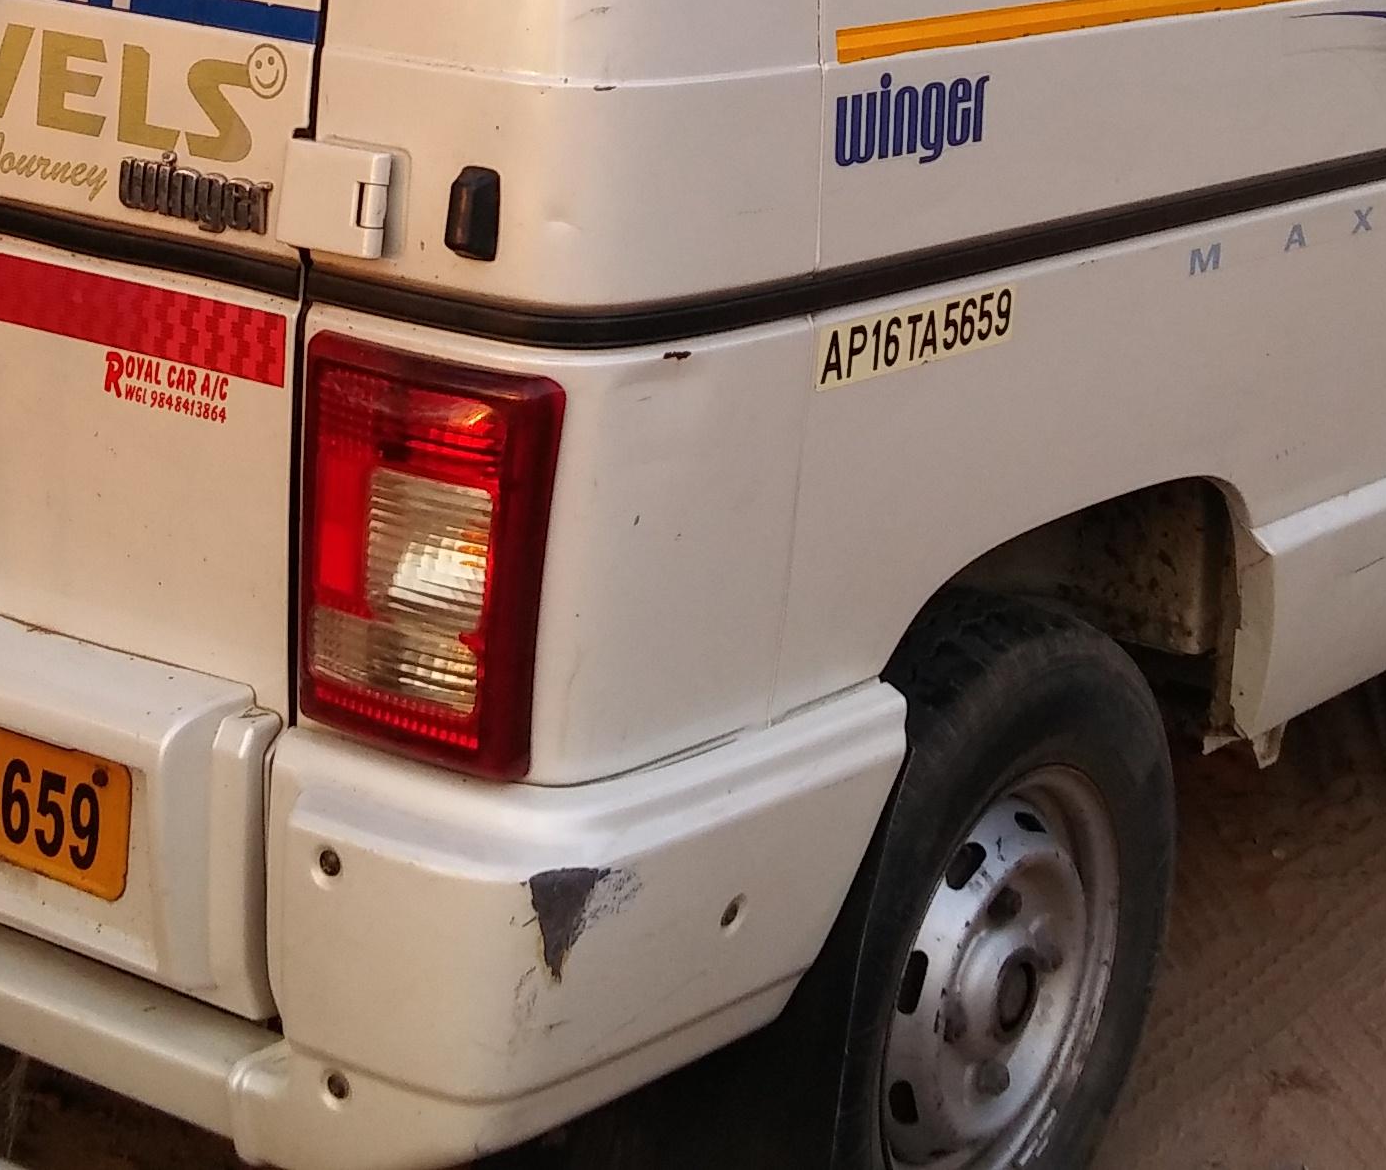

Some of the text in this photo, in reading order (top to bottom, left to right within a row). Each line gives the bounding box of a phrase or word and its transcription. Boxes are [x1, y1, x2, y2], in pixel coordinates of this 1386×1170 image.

[835, 72, 990, 166] winger
[119, 151, 273, 235] winger
[104, 351, 229, 401] ROYAL CAR A/C
[125, 383, 226, 424] WGL 9848413864
